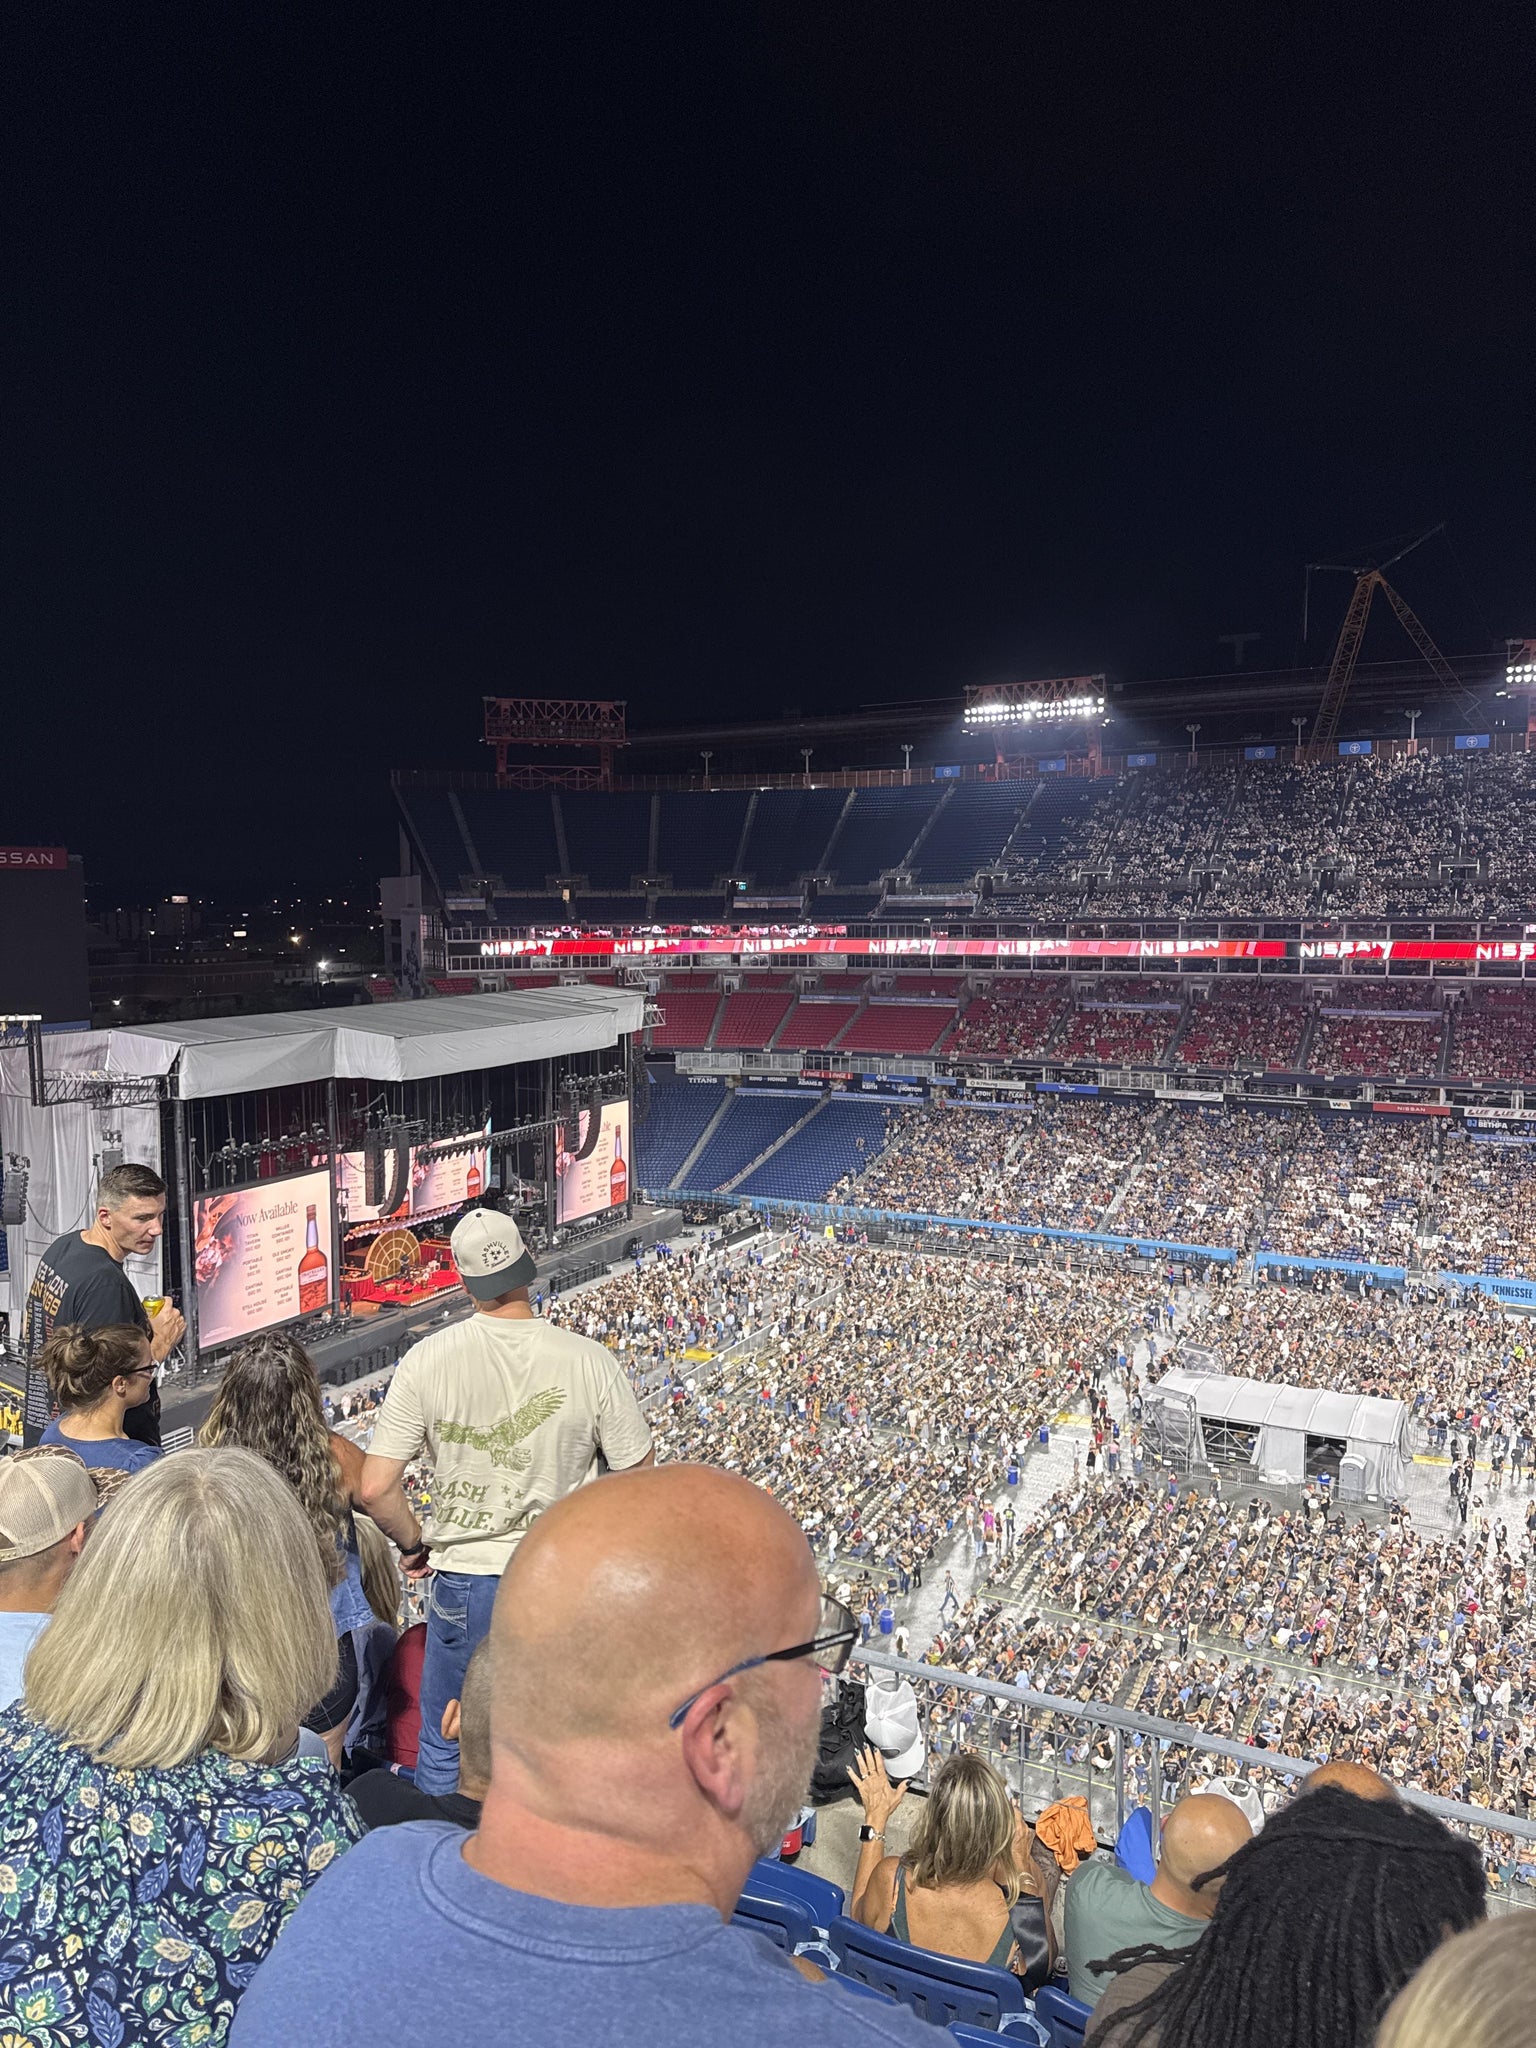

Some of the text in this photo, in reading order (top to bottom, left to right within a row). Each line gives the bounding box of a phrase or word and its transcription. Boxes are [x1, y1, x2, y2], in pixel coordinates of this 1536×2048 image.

[0, 852, 54, 865] SSAN
[481, 940, 550, 956] NISSAN
[615, 939, 680, 954] NISSAN
[743, 938, 807, 952] NISSAN
[869, 939, 931, 954] NISSAN
[998, 939, 1069, 956] NISSAN
[1140, 940, 1219, 956] NISSAN
[1300, 941, 1386, 958] NISSAN
[1476, 942, 1535, 960] NISS
[236, 1201, 298, 1229] Now Available
[481, 1240, 509, 1264] NASHVILLE
[1492, 1284, 1533, 1299] TENNESSEE
[433, 1478, 491, 1504] NASH
